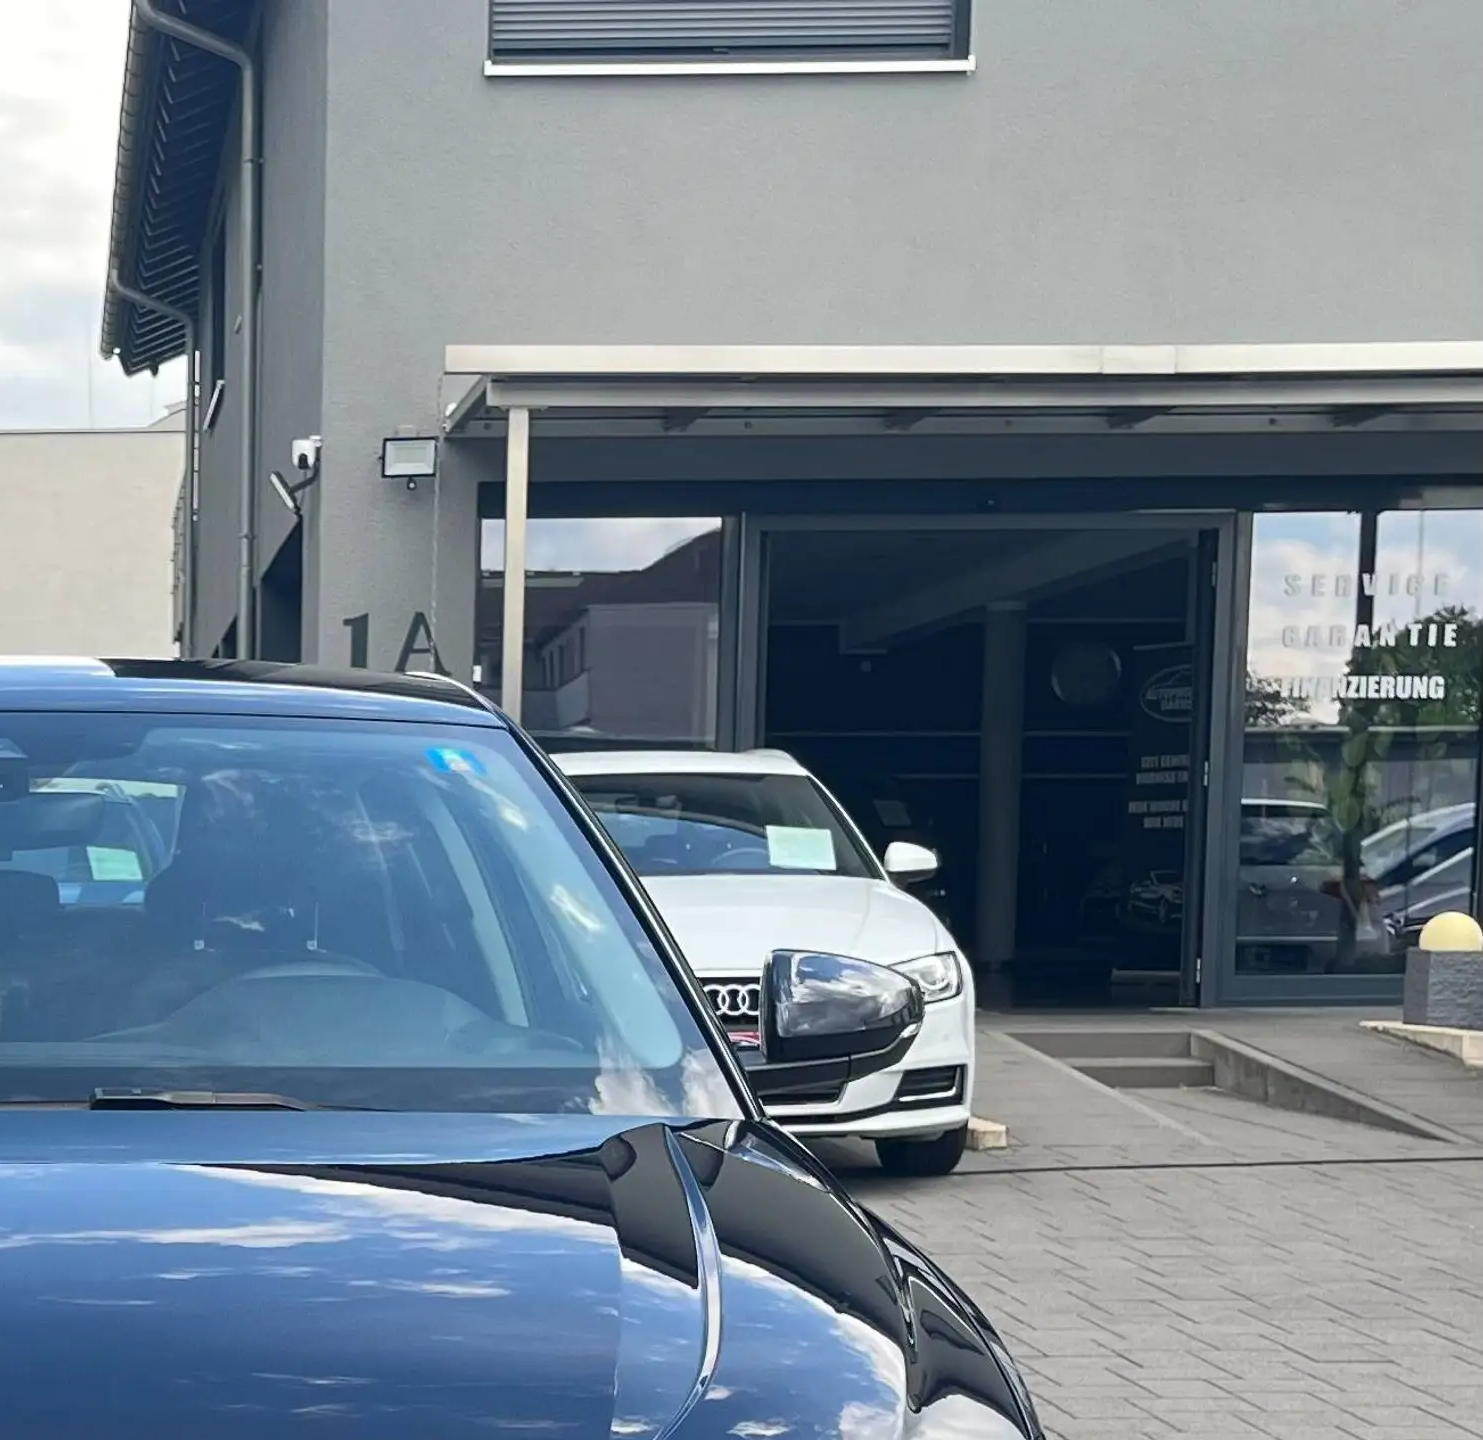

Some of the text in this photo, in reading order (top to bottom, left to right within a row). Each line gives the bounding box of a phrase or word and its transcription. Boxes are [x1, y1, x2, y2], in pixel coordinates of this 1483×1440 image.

[1283, 572, 1450, 598] SERVICE
[1281, 622, 1458, 648] GARANTIE
[1280, 674, 1446, 700] FINANZIERUNG
